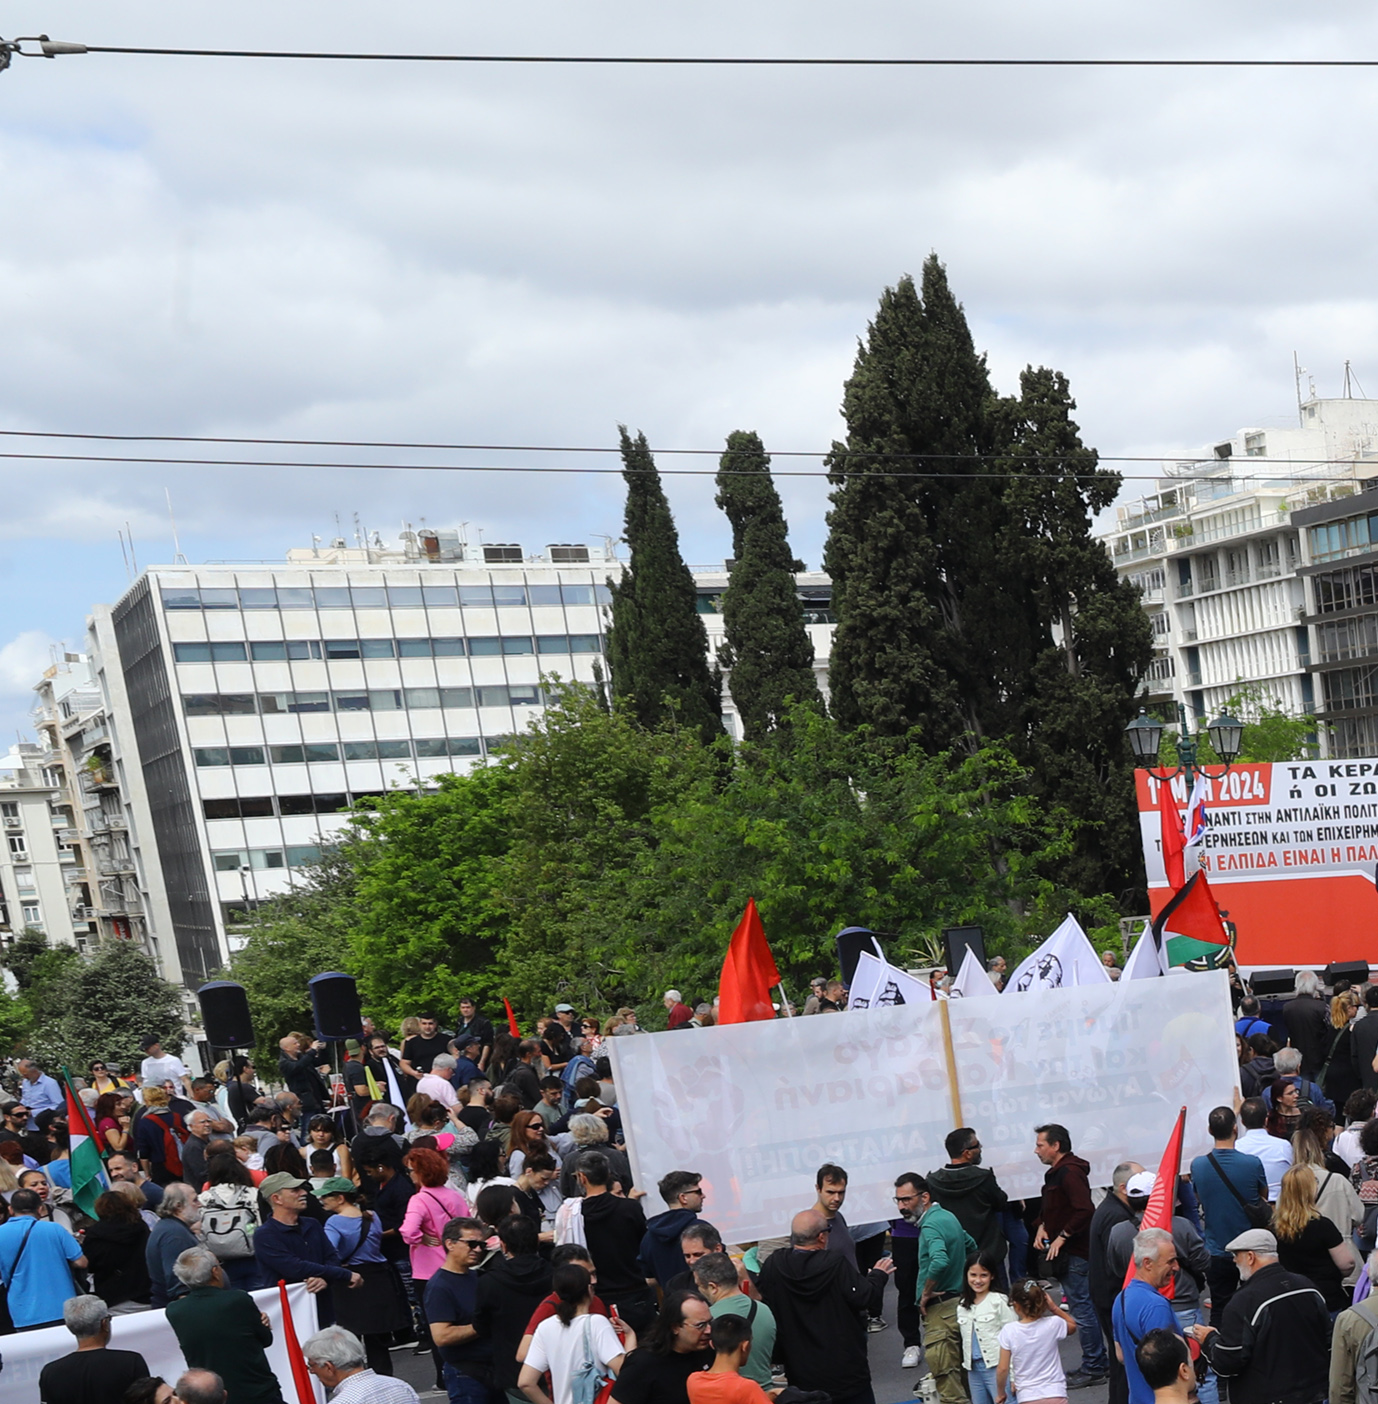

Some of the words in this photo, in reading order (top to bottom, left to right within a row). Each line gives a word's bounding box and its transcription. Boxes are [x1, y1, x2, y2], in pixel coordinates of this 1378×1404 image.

[1288, 767, 1316, 780] ΤΑ
[1219, 771, 1264, 800] 2024
[1290, 785, 1302, 798] ή
[1315, 784, 1336, 797] ΟΙ
[1246, 811, 1271, 825] ΣΤΗΝ
[1276, 803, 1340, 823] ΑΝΤΙΛΑΪΚΗ
[1272, 831, 1289, 844] ΚΑΙ
[1293, 830, 1313, 842] ΤΩΝ
[1217, 852, 1277, 871] ΕΛΠΙΔΑ
[1283, 849, 1325, 866] ΕΙΝΑΙ
[1332, 848, 1341, 863] Η
